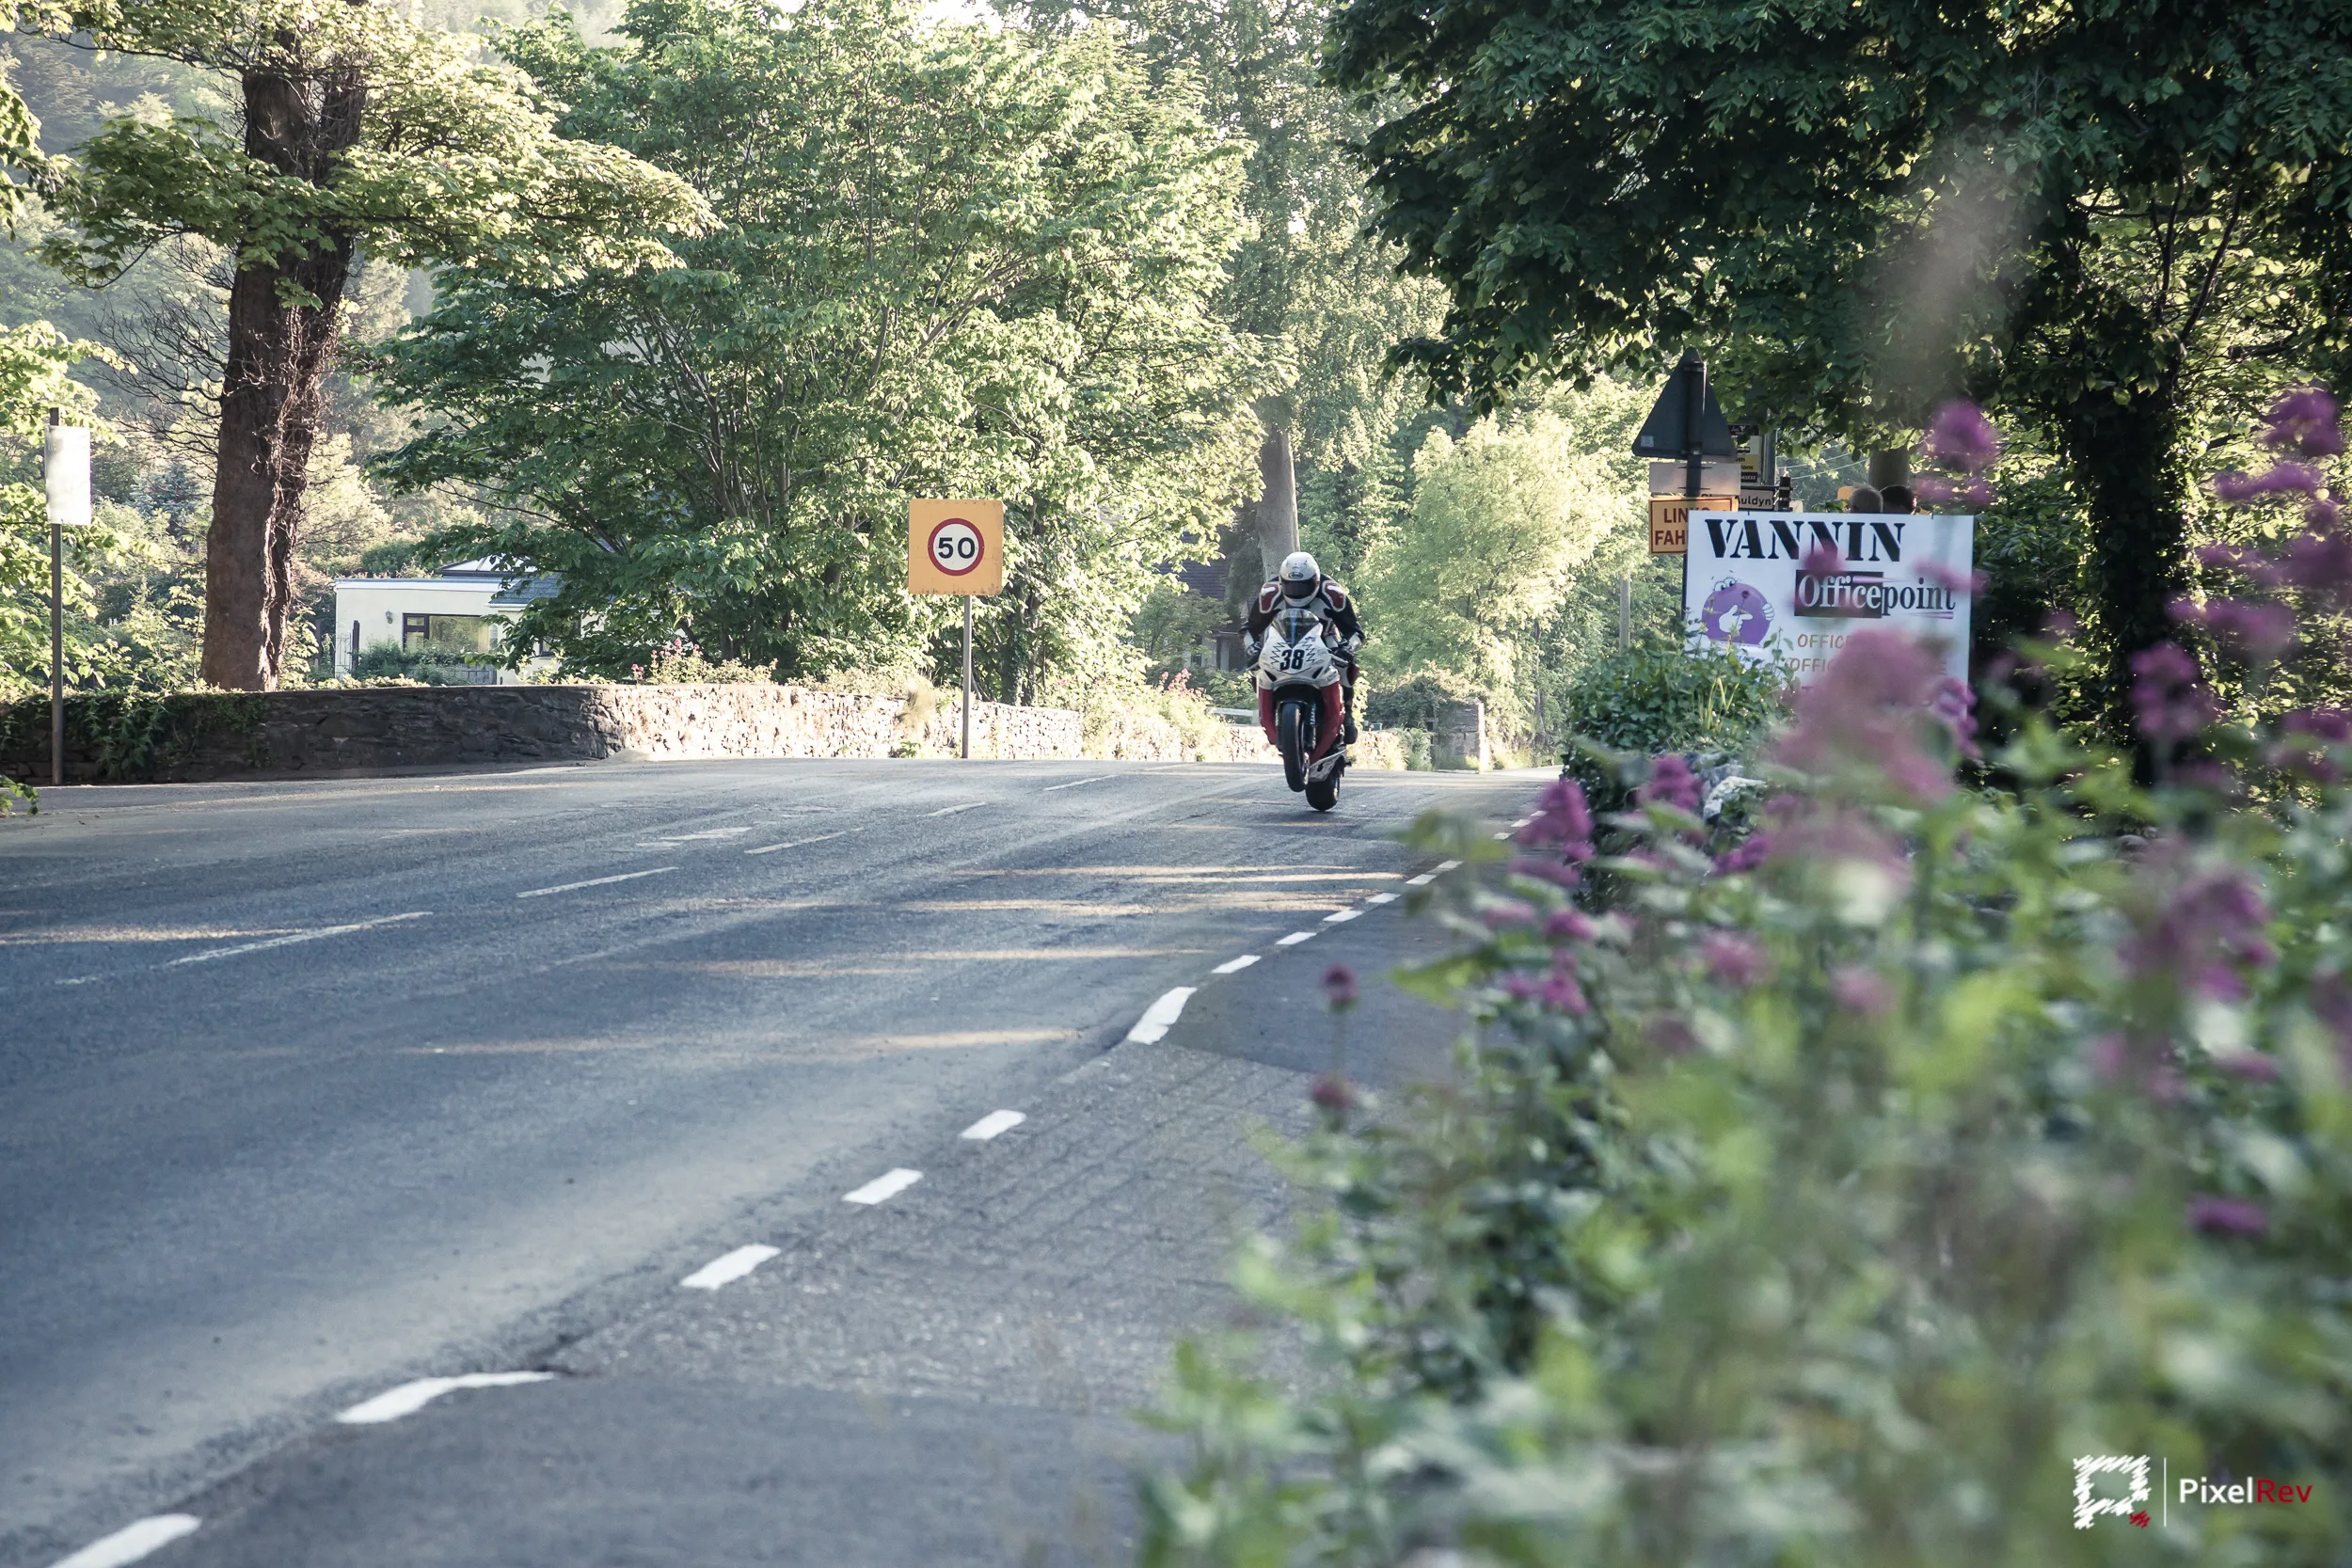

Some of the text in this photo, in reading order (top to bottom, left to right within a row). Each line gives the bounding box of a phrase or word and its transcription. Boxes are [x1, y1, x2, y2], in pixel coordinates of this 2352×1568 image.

[1663, 507, 1705, 523] LIN
[1655, 530, 1688, 546] FAH
[1705, 518, 1905, 562] VANNIN
[938, 537, 976, 559] 50
[1799, 575, 1956, 616] Officepoint
[1797, 633, 1847, 649] OFFIC
[1279, 649, 1306, 671] 38
[1789, 657, 1831, 673] OFFI
